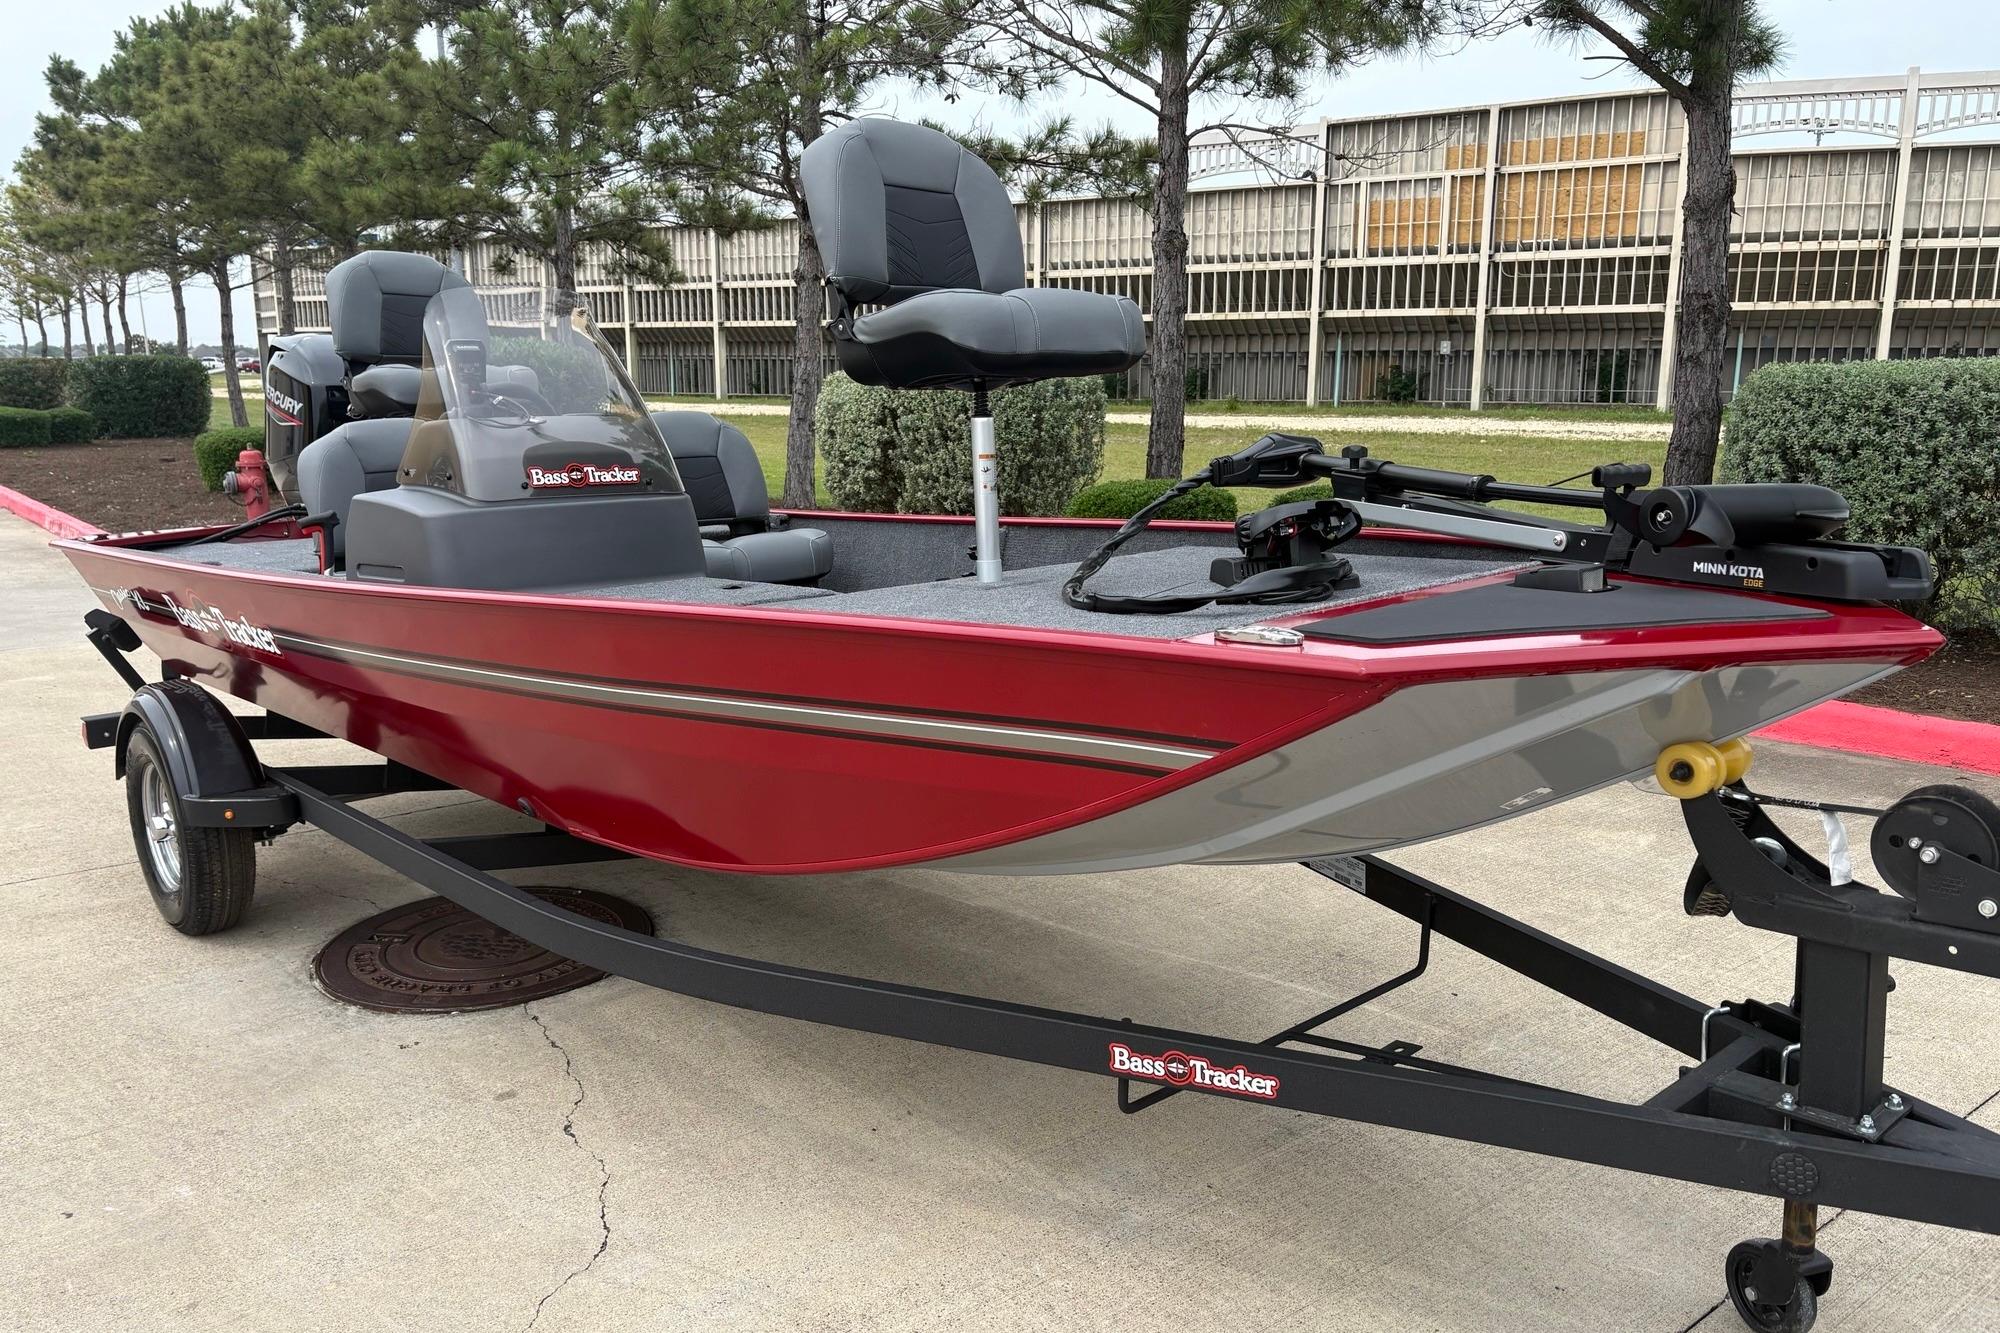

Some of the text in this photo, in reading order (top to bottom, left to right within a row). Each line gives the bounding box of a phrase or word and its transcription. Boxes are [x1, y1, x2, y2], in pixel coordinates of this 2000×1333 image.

[266, 387, 304, 416] ERCURY
[530, 466, 639, 485] Bass Tracker
[1693, 561, 1764, 579] MINN KOTA
[1743, 578, 1764, 588] EDGE
[161, 593, 209, 634] Bass
[208, 606, 282, 655] Tracker
[536, 961, 580, 983] ITY
[1111, 1045, 1277, 1096] Bass Tracker
